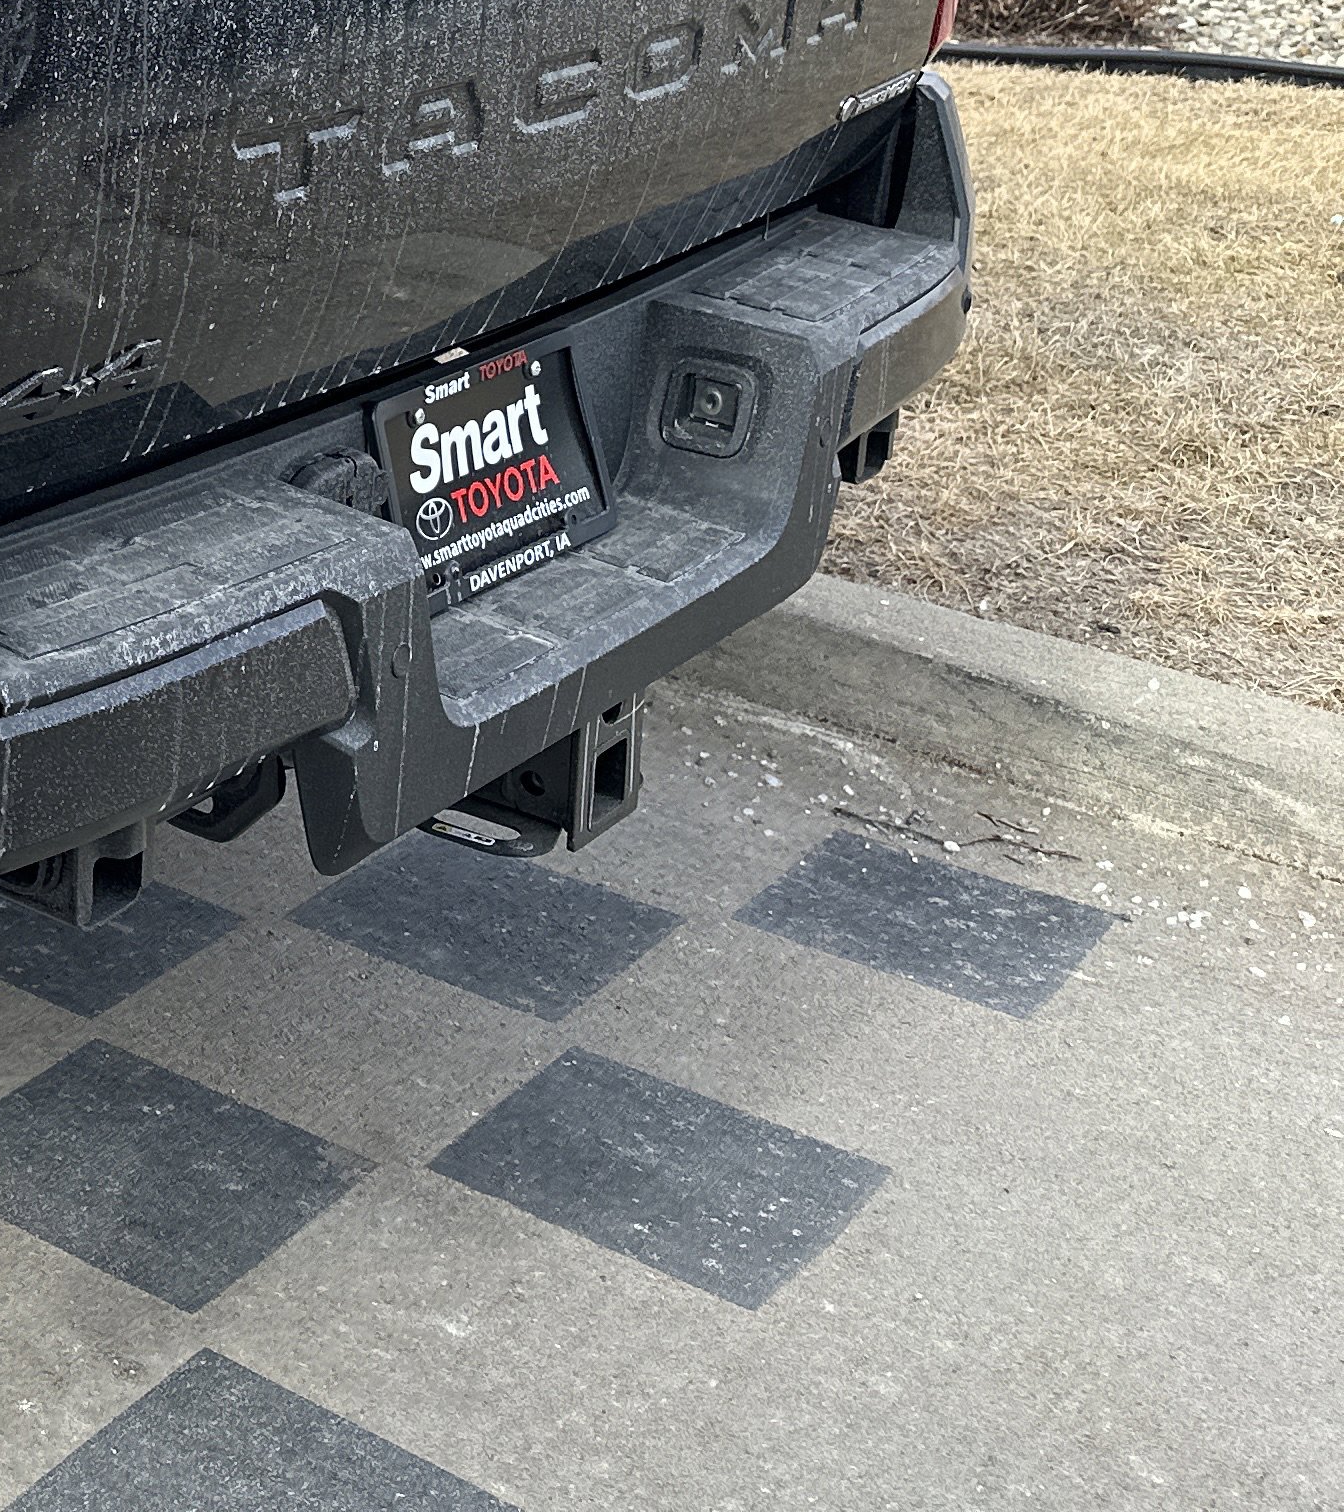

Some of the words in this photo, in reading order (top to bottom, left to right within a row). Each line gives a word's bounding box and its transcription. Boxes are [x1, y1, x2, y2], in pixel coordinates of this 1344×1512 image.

[424, 370, 471, 404] Smart
[479, 349, 529, 382] TOYOTA
[409, 384, 549, 494] Smart
[450, 454, 561, 523] TOYOTA
[469, 539, 555, 592] DAVENPORT,
[555, 532, 572, 552] IA
